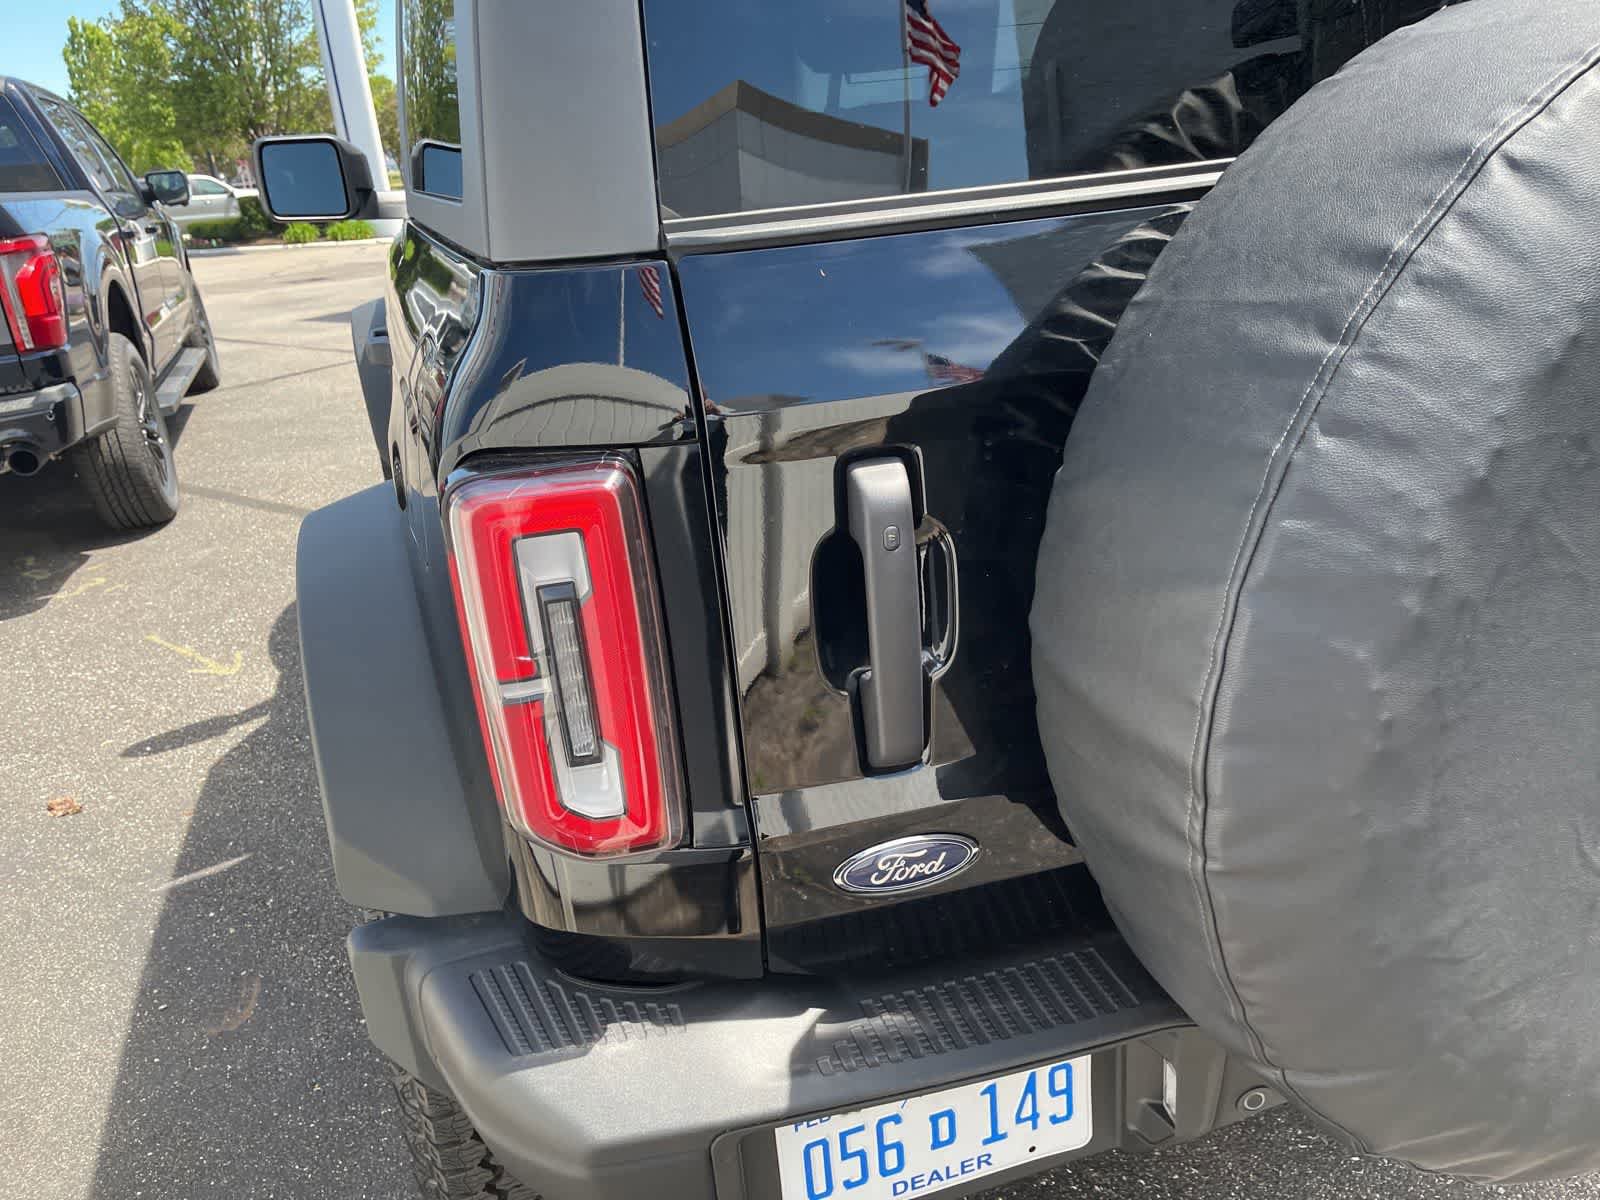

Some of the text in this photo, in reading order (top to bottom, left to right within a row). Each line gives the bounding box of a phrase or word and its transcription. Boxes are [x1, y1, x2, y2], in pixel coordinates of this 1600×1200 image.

[870, 849, 947, 885] Ford
[803, 1062, 1074, 1200] 056 D 149
[892, 1153, 993, 1196] DEALER
